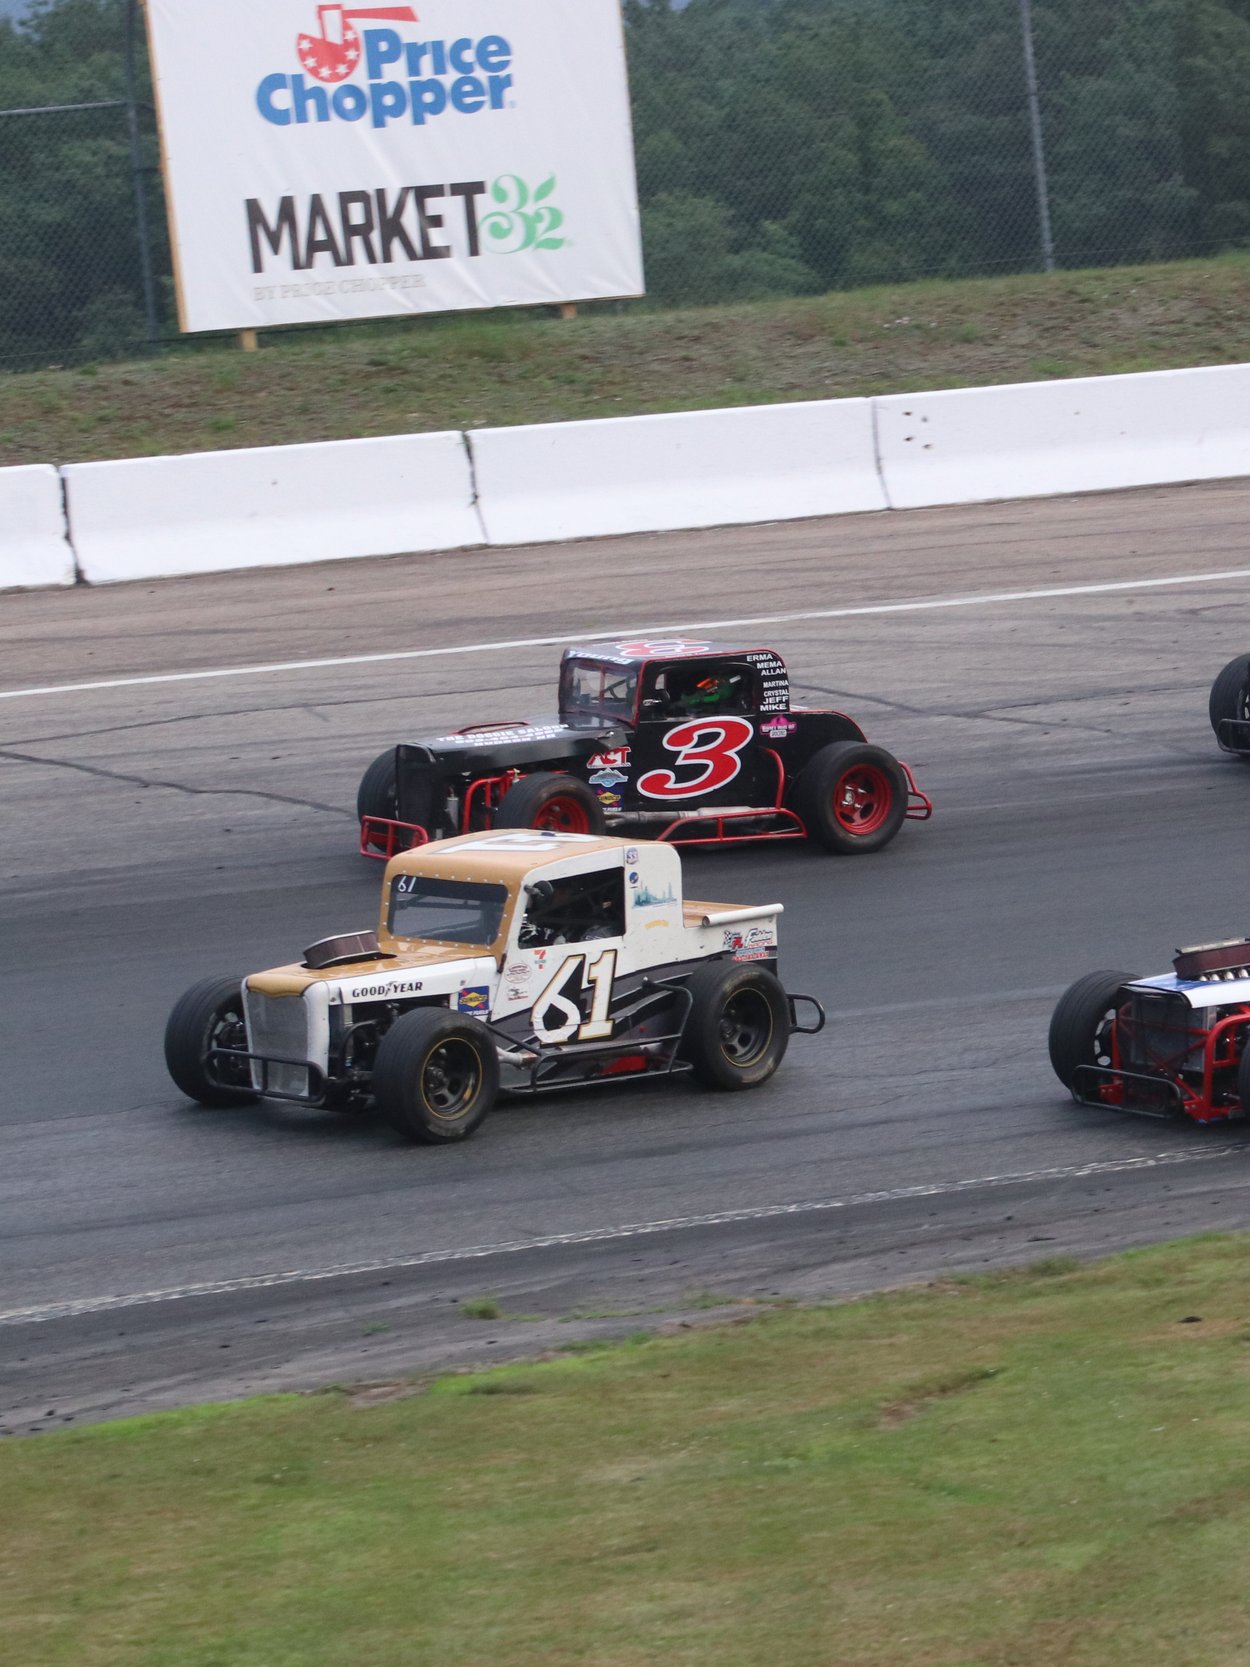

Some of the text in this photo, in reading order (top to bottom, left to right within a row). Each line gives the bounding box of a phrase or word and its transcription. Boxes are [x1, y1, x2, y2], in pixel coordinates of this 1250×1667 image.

[363, 28, 512, 80] Price
[255, 72, 513, 128] Chopper
[245, 173, 567, 274] MARKET 32
[567, 650, 635, 665] Young
[746, 654, 773, 662] ERMA
[757, 661, 783, 669] MEMA
[761, 668, 786, 676] ALLAN
[763, 680, 789, 688] MARTINA
[763, 689, 790, 697] CRYSTAL
[763, 696, 789, 704] JEFF
[760, 703, 787, 711] MIKE
[637, 714, 754, 800] 3
[397, 875, 417, 893] 61
[530, 948, 618, 1047] 61
